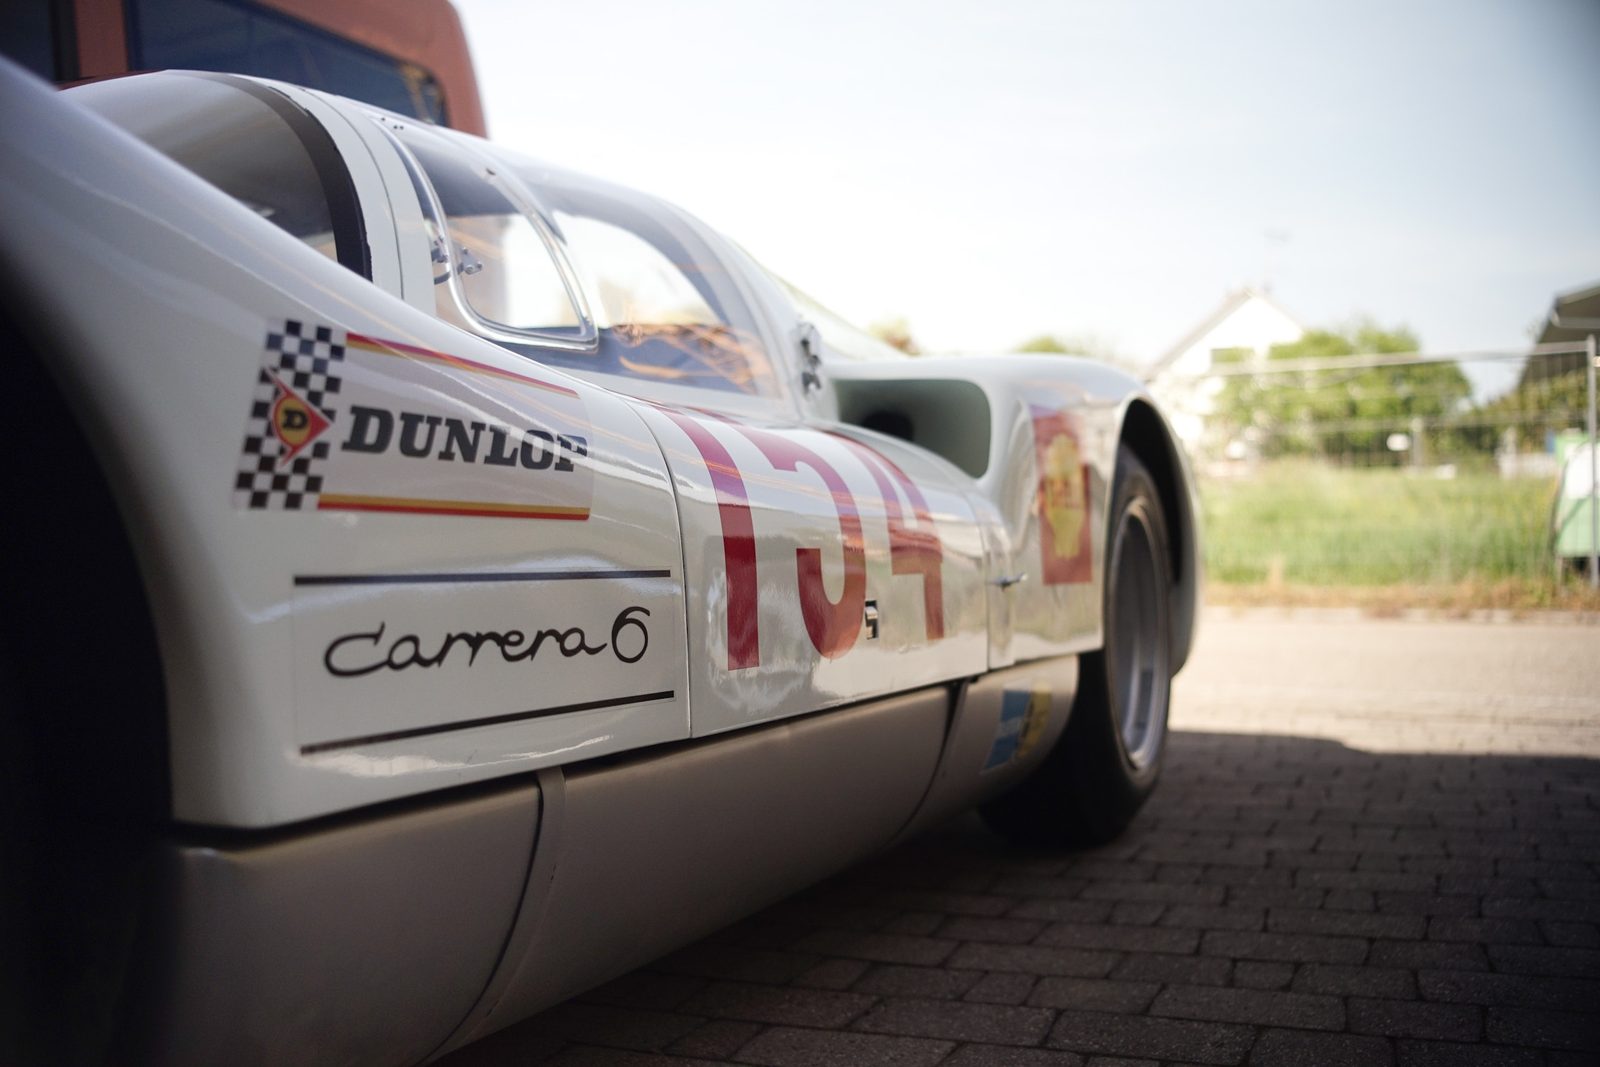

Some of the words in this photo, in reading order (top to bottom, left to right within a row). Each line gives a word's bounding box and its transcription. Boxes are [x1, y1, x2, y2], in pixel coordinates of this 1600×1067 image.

[282, 408, 309, 430] D
[341, 405, 588, 473] DUNLOP
[611, 606, 651, 664] 6
